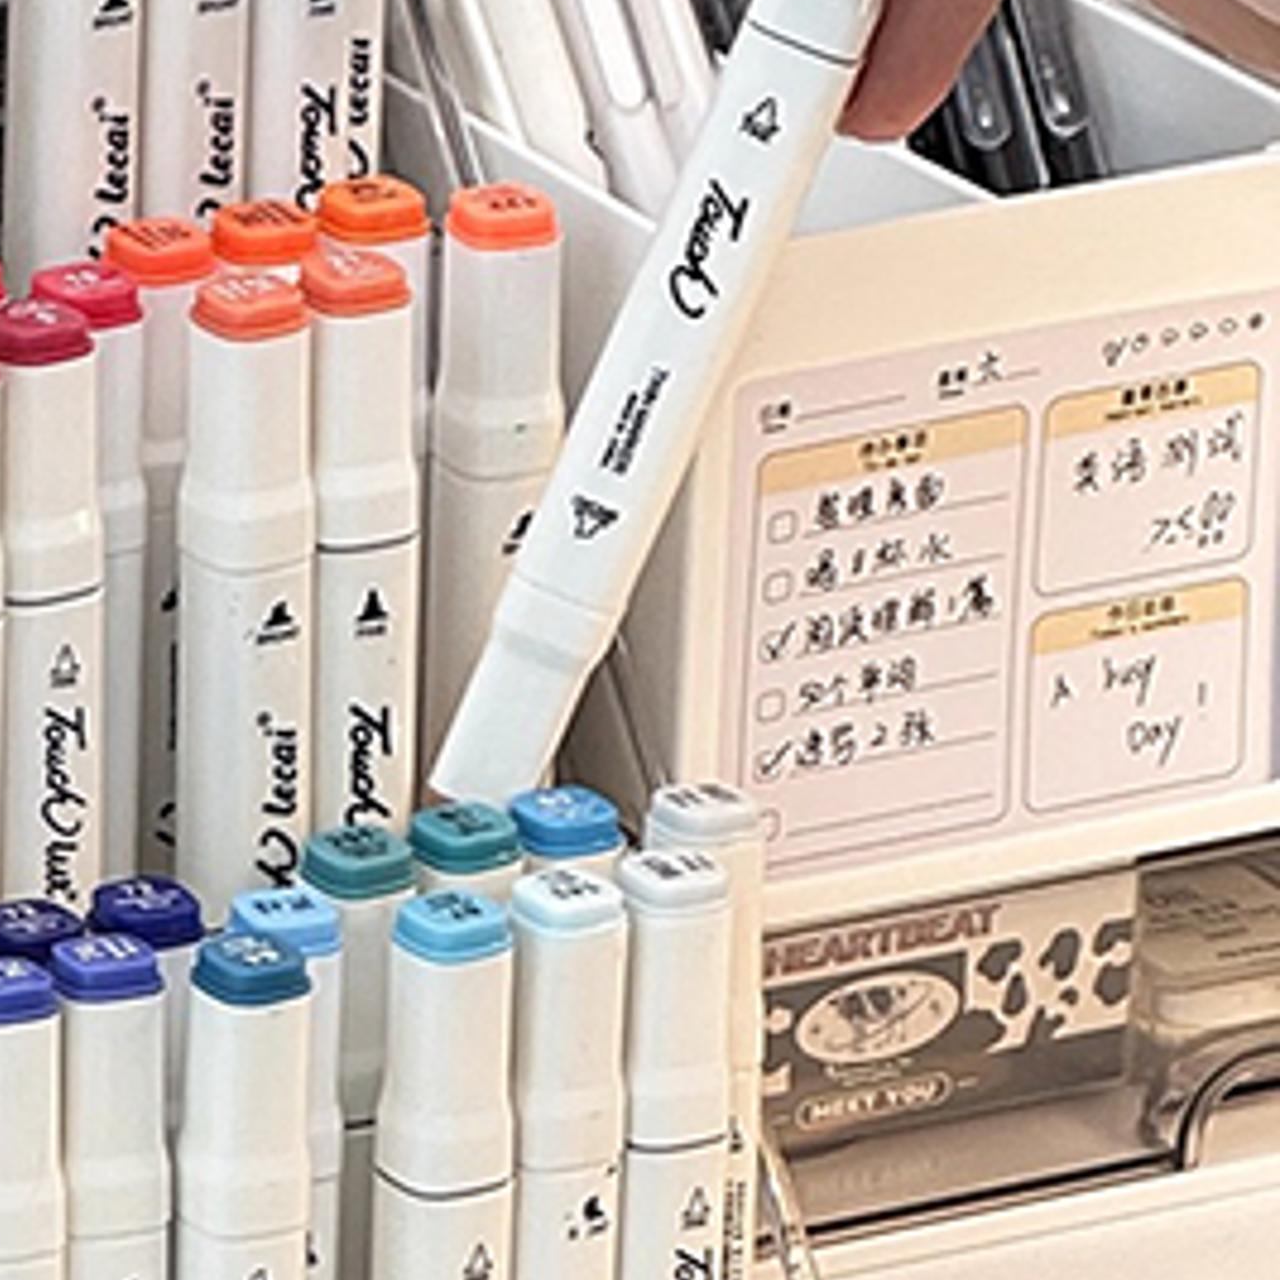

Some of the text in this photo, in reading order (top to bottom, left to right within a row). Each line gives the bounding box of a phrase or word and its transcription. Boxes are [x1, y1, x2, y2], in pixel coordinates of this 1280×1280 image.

[668, 178, 750, 320] Touch
[41, 706, 87, 839] Touch
[762, 901, 1003, 982] HEARTBEAT
